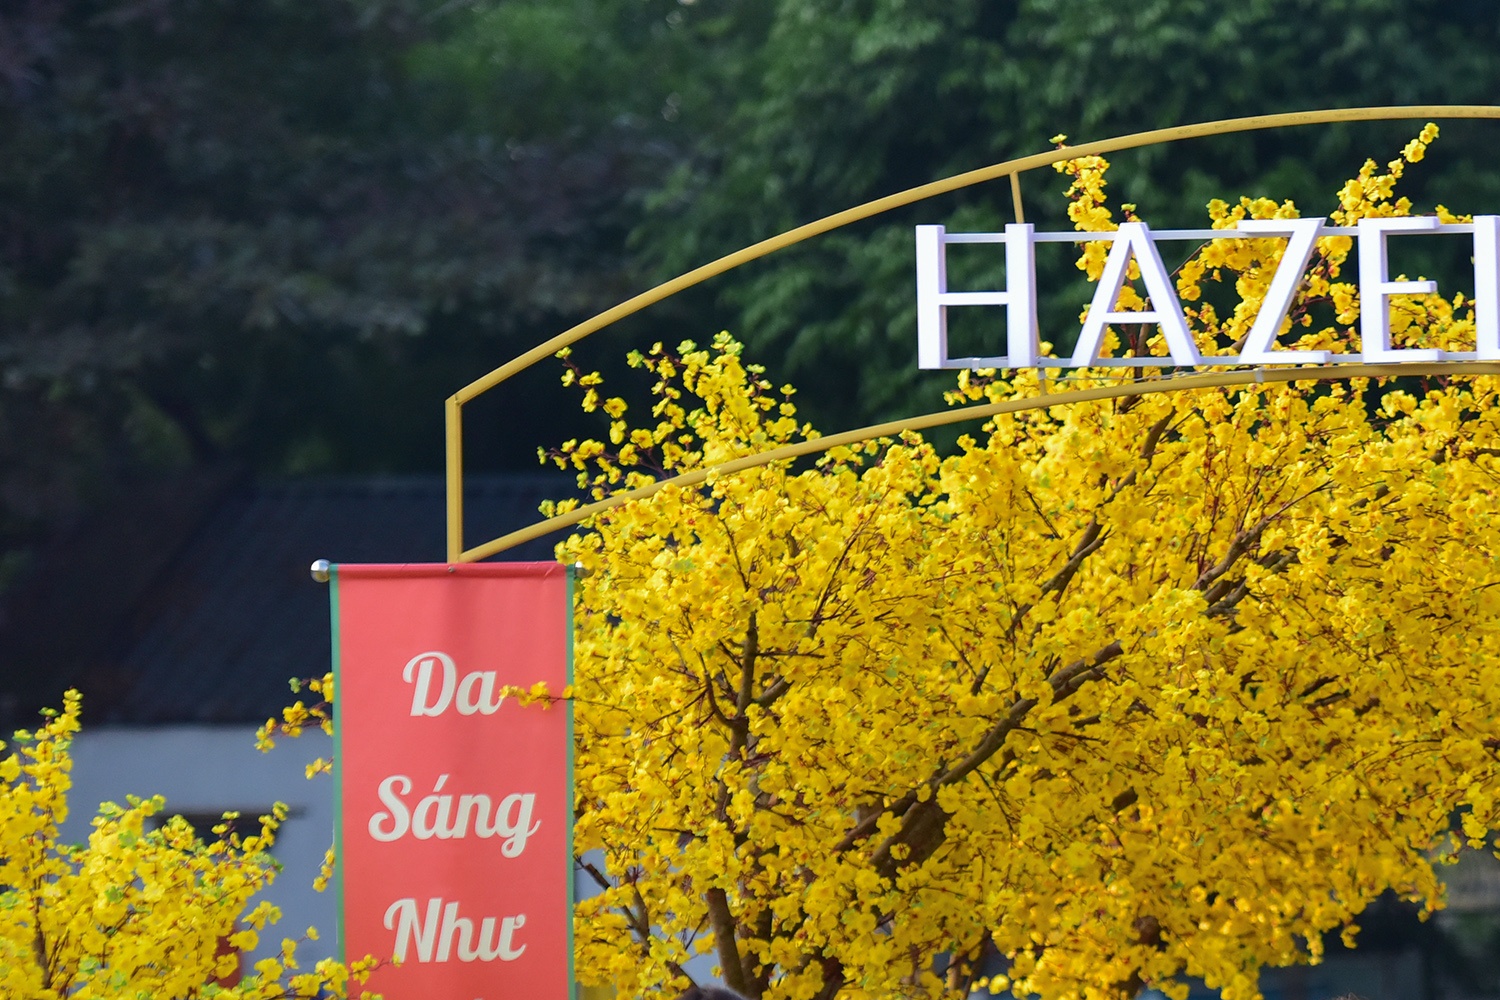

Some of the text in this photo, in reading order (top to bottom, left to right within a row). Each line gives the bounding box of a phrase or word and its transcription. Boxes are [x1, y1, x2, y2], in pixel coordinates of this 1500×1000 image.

[402, 651, 504, 717] Da
[368, 774, 542, 858] Sáng
[383, 898, 527, 963] Như
